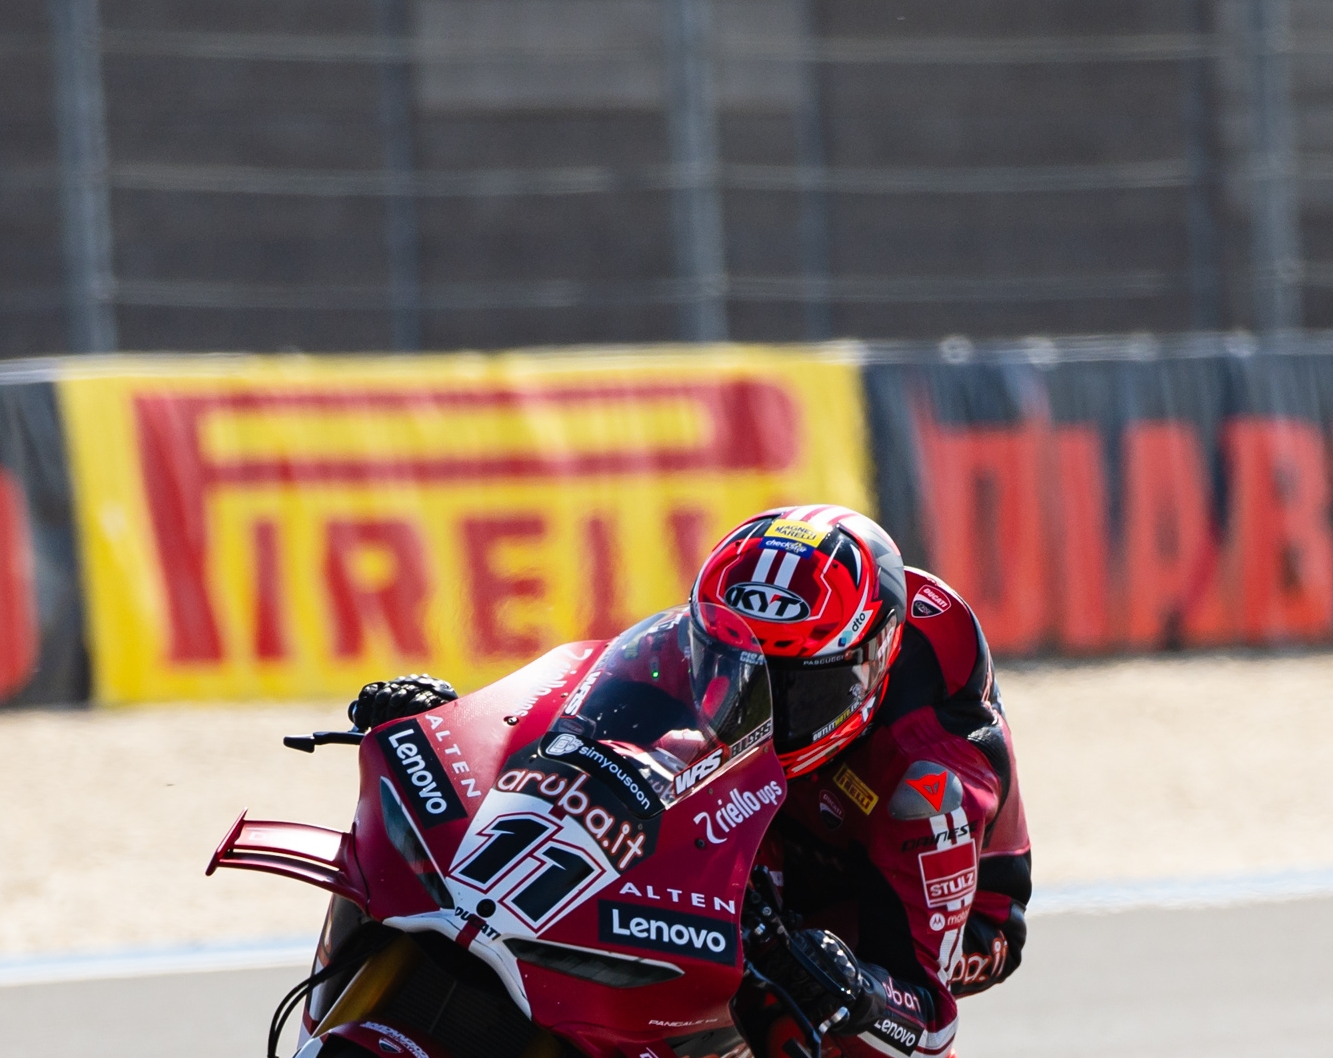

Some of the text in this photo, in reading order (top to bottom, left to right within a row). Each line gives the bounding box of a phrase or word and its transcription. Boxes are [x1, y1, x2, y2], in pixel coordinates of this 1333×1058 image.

[131, 378, 802, 668] PIREL
[731, 587, 802, 618] KYT
[923, 588, 948, 608] DUCATI
[851, 612, 866, 633] dto
[388, 729, 447, 814] Lenovo
[425, 713, 482, 798] ALTEN
[578, 745, 651, 810] simyousoon
[675, 748, 724, 795] WRS
[497, 770, 645, 869] aruba.it
[715, 780, 783, 833] riello ups
[457, 817, 596, 923] 11
[930, 871, 974, 897] STULZ
[619, 882, 736, 915] ALTEN
[612, 909, 726, 953] Lenovo
[873, 1018, 916, 1048] Lenovo
